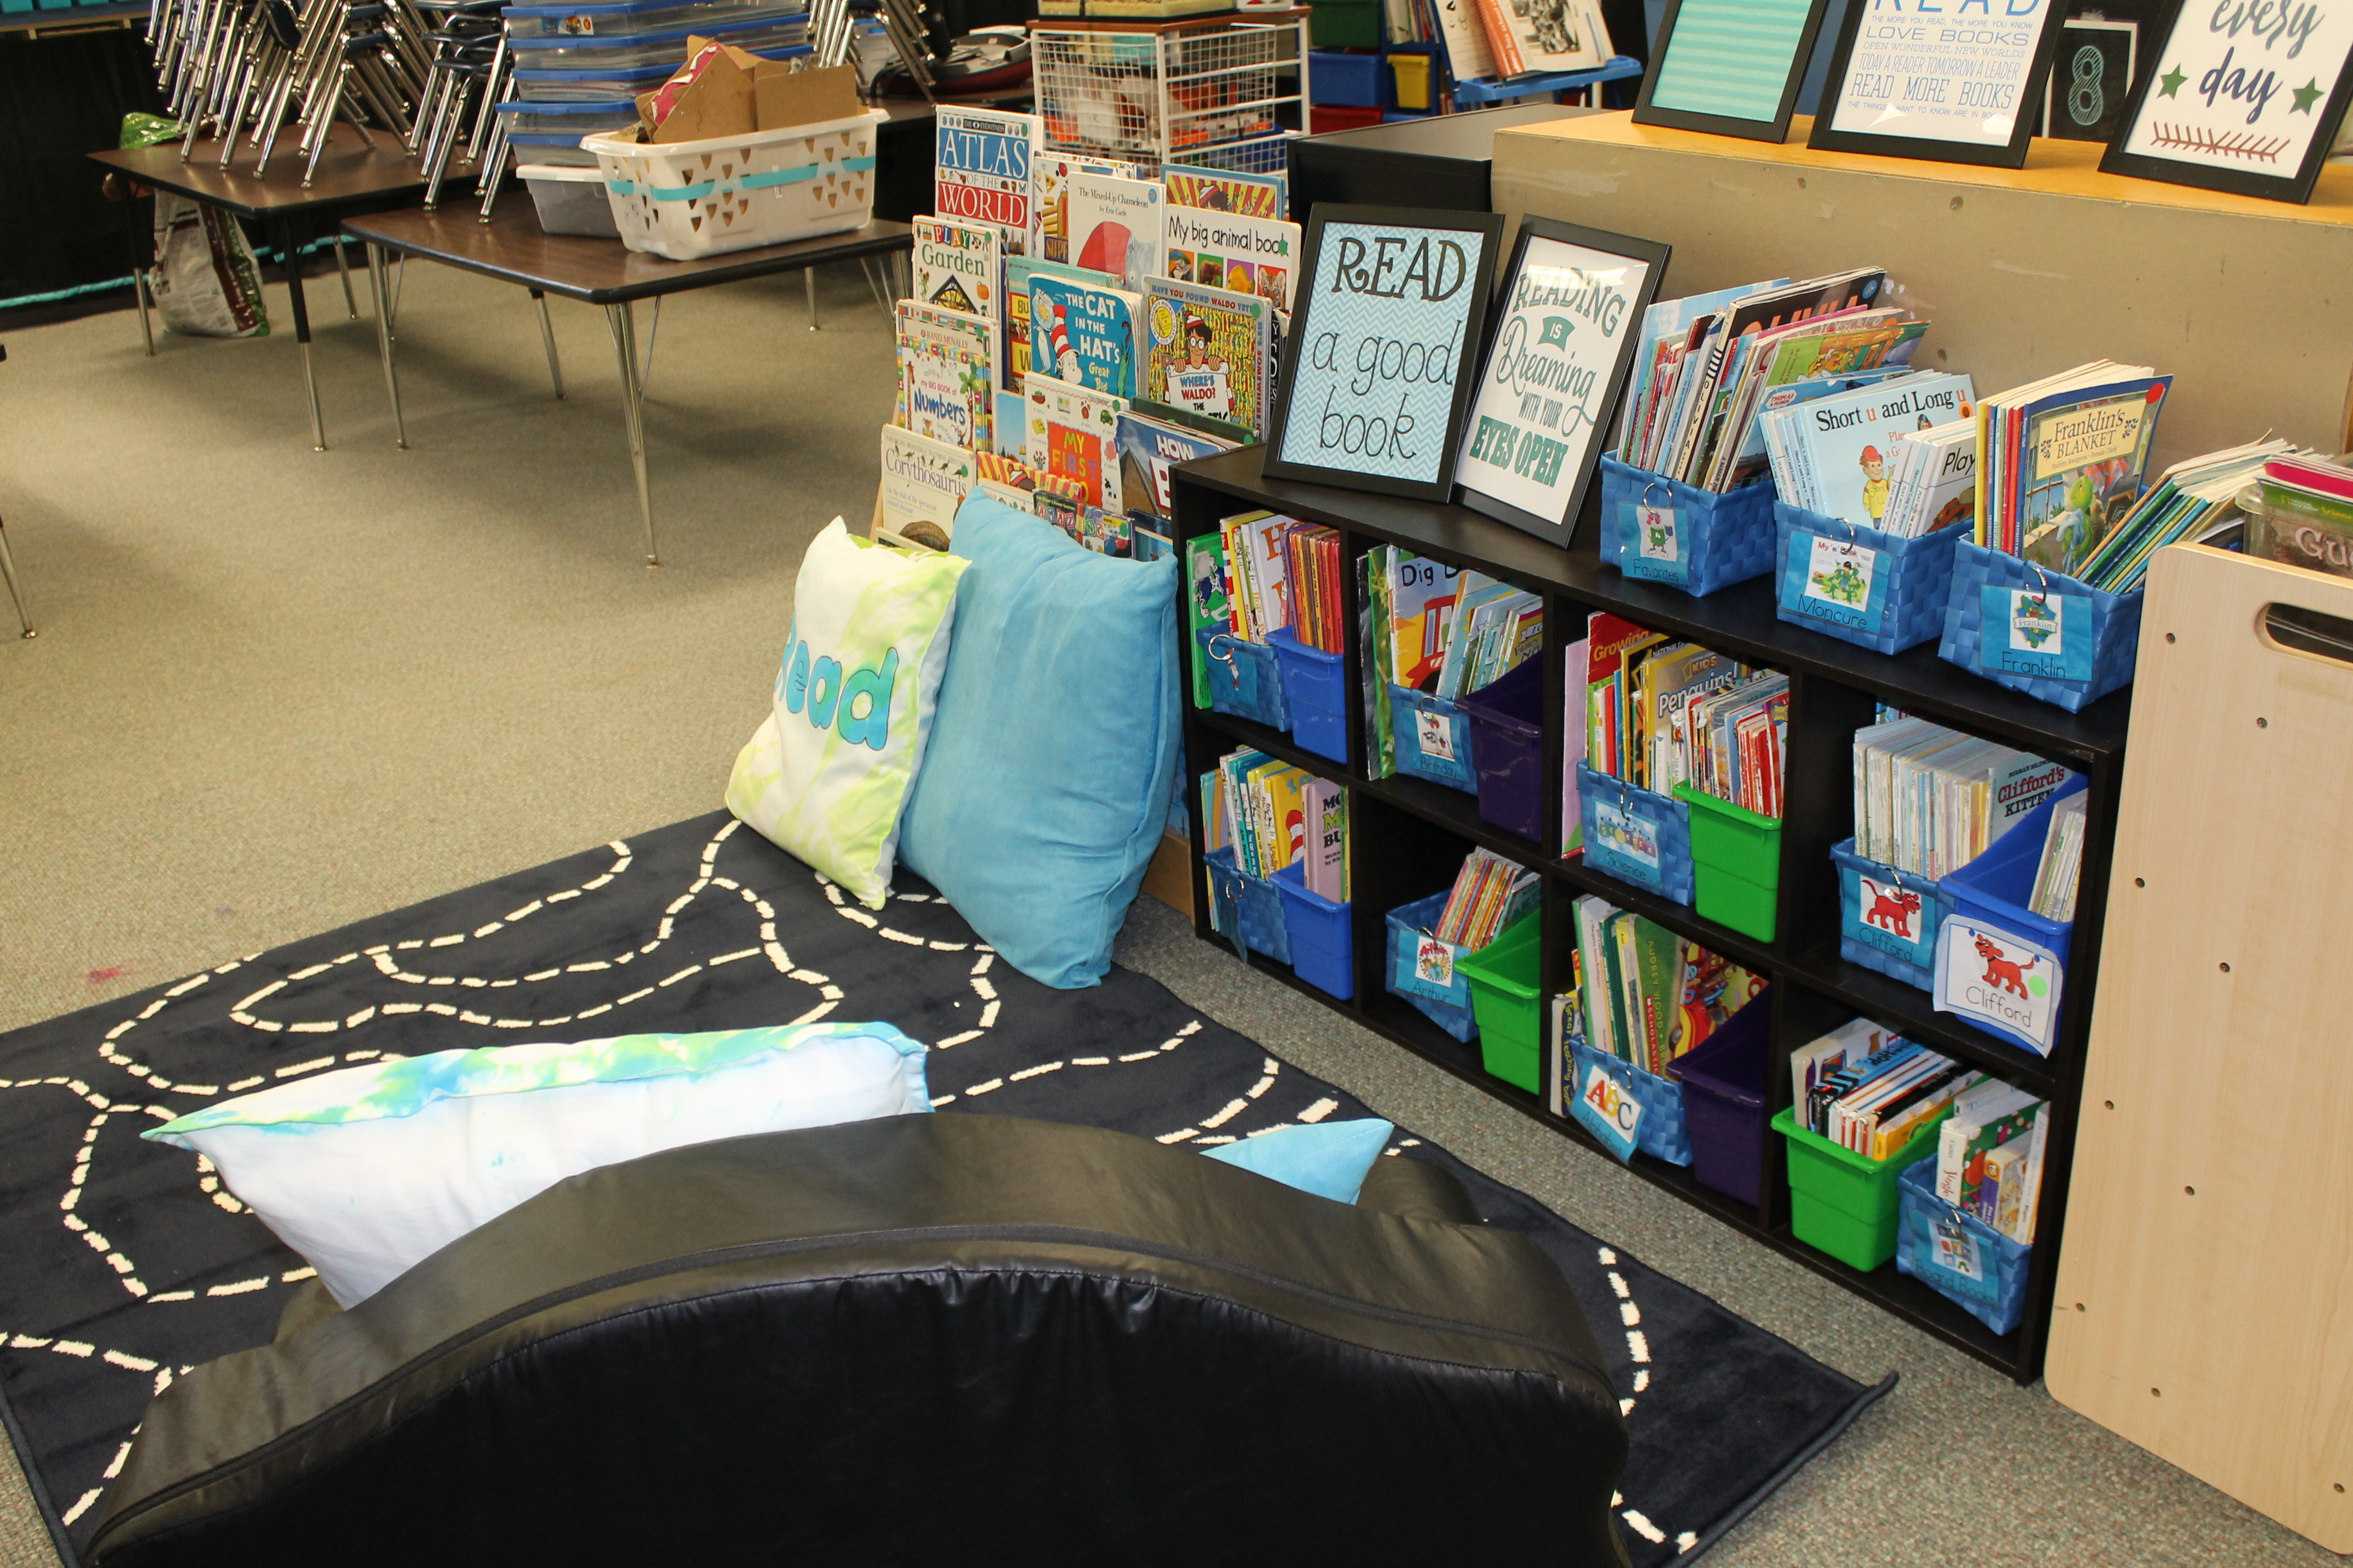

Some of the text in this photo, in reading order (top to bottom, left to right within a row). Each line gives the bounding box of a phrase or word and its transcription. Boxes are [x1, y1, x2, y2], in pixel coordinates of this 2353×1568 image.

[1863, 42, 2025, 58] OPEN WONDERFUL NEW WORLDS
[1866, 26, 2029, 46] LOVE BOOKS
[1858, 53, 2021, 80] TODAY A READER TOMORROW A LEADER
[1850, 73, 2014, 109] READ MORE BOOKS
[2068, 46, 2104, 125] 8
[2199, 46, 2284, 125] day
[941, 130, 1025, 179] ATLAS
[967, 174, 999, 189] OF THE
[939, 183, 1025, 225] WORLD
[1079, 187, 1148, 208] The Mixed-Up Chameleon
[1100, 205, 1104, 214] by
[1115, 208, 1126, 216] Carle
[934, 227, 969, 247] PLAY
[1168, 215, 1188, 245] My
[1191, 219, 1208, 247] big
[1212, 228, 1251, 251] animal
[921, 244, 985, 276] Garden
[1331, 236, 1466, 301] READ
[1065, 293, 1116, 320] THE CAT
[1152, 285, 1168, 295] HAVE
[1170, 289, 1184, 298] YOU
[1186, 292, 1209, 303] FOUND
[1212, 298, 1235, 309] WALDO
[1512, 266, 1626, 337] READING
[927, 331, 942, 342] RAND
[1075, 317, 1105, 335] IN THE
[1549, 322, 1563, 339] IS
[1080, 335, 1120, 364] HAT'S
[1312, 332, 1339, 373] a
[1351, 320, 1462, 395] good
[1089, 362, 1110, 378] Great
[1095, 377, 1108, 392] Big
[1180, 375, 1215, 386] WHERE'S
[1496, 315, 1597, 437] Dreaming
[937, 383, 950, 393] BOOK
[1181, 387, 1216, 400] WALDO?
[1771, 393, 1794, 402] THOMAS
[914, 387, 965, 425] Numbers
[1518, 391, 1563, 430] WITH YOUR
[1684, 380, 1710, 449] OLIVIA
[1815, 389, 1967, 432] Short u and Long u
[1319, 385, 1416, 460] book
[2054, 409, 2126, 442] Franklin's
[1064, 431, 1084, 454] MY
[1156, 434, 1194, 460] HOW
[1469, 415, 1569, 488] EYES OPEN
[2056, 430, 2116, 460] BLANKET
[886, 448, 966, 497] Corythosaurus
[1052, 449, 1097, 481] FIRST
[1942, 446, 1975, 476] Play
[1818, 542, 1829, 551] My
[1401, 563, 1434, 588] Dig
[1633, 559, 1679, 583] Favorites
[1251, 591, 1263, 613] HOP
[1798, 594, 1867, 629] Moncure
[2018, 618, 2052, 631] Franklin
[1593, 630, 1649, 662] Growing
[1692, 655, 1718, 674] KIDS
[2001, 651, 2066, 678] Franklin
[1420, 756, 1458, 779] Birthday
[1999, 766, 2065, 804] Clifford's
[1607, 852, 1646, 880] Science
[1858, 927, 1914, 962] Clifford
[1412, 980, 1449, 1004] Arthur
[1645, 940, 1665, 1028] AUDREY WOOD
[1565, 1005, 1574, 1034] Great
[1965, 985, 2032, 1028] Clifford
[1647, 1006, 1659, 1075] SCHOLASTIC
[1562, 1039, 1575, 1081] teaching
[1586, 1080, 1634, 1130] ABC
[1941, 1170, 1958, 1197] Jingle
[1915, 1258, 1996, 1305] Board Books
